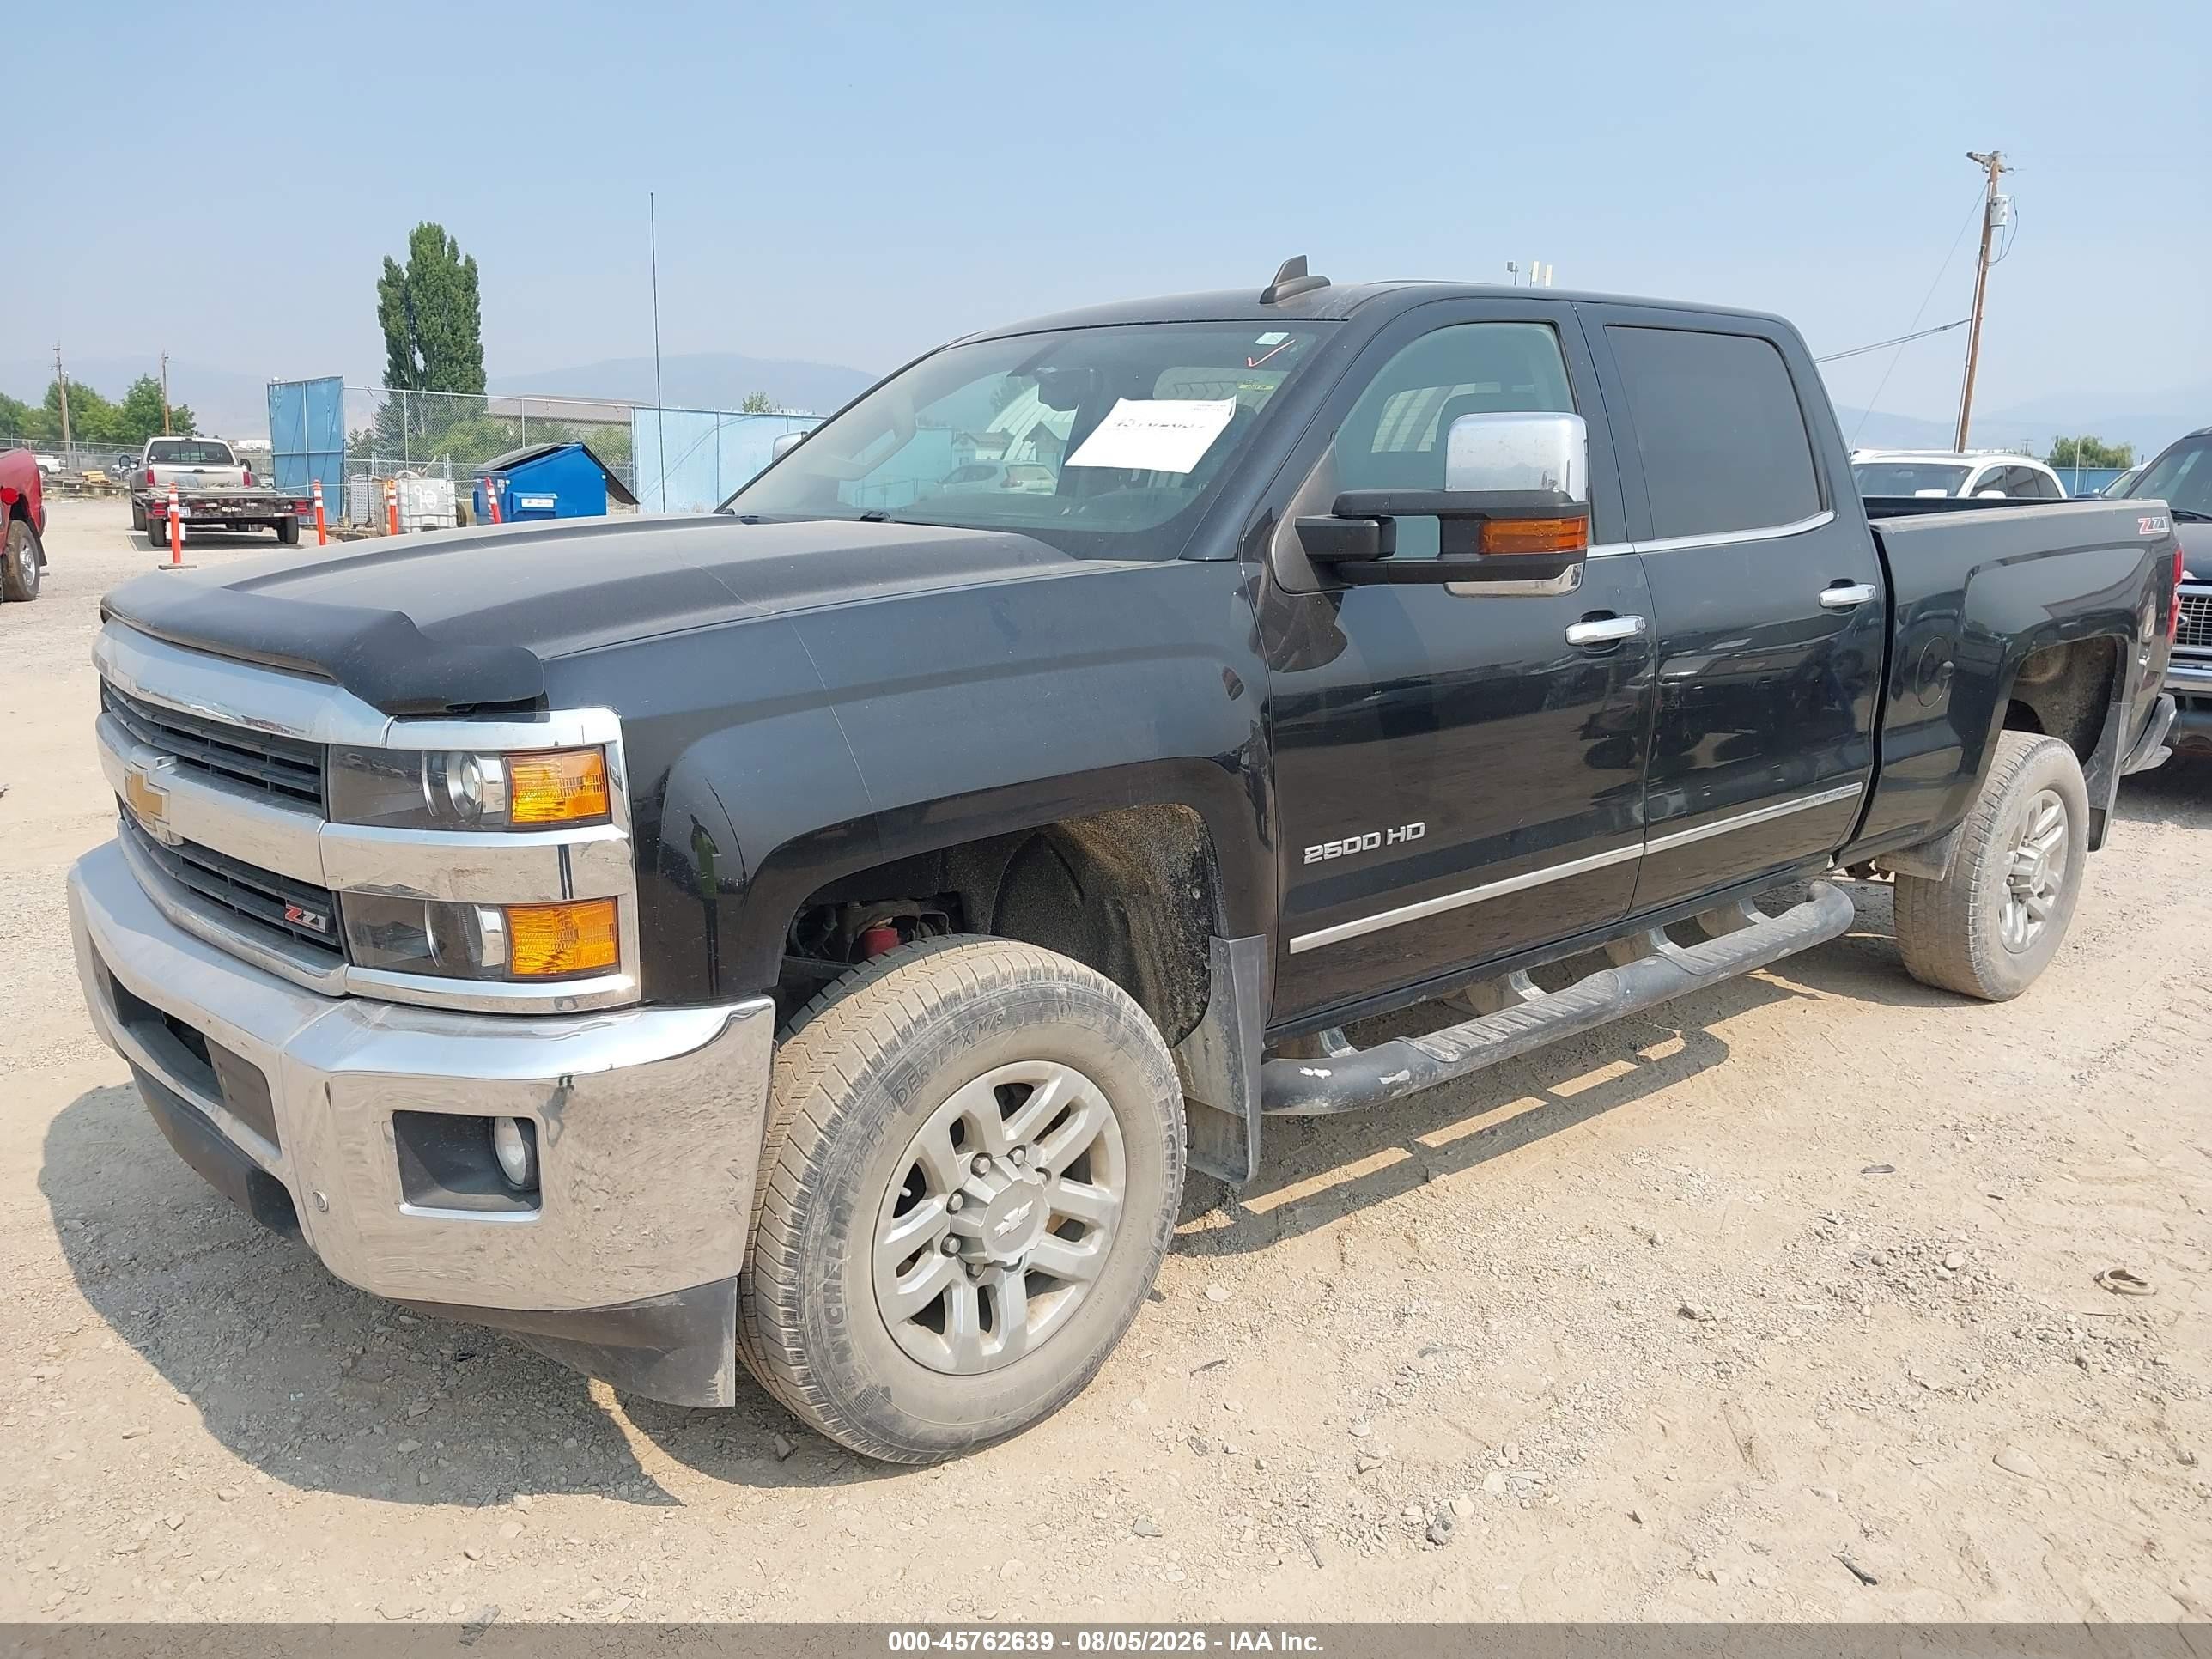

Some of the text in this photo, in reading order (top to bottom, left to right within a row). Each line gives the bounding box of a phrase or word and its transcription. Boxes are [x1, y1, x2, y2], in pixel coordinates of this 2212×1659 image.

[2137, 516, 2170, 535] Z71
[1303, 821, 1425, 866] 2500 HD
[284, 903, 326, 933] Z71
[850, 1065, 931, 1179] DEFENDER
[936, 1028, 977, 1066] LTX
[977, 1012, 1005, 1037] M/S
